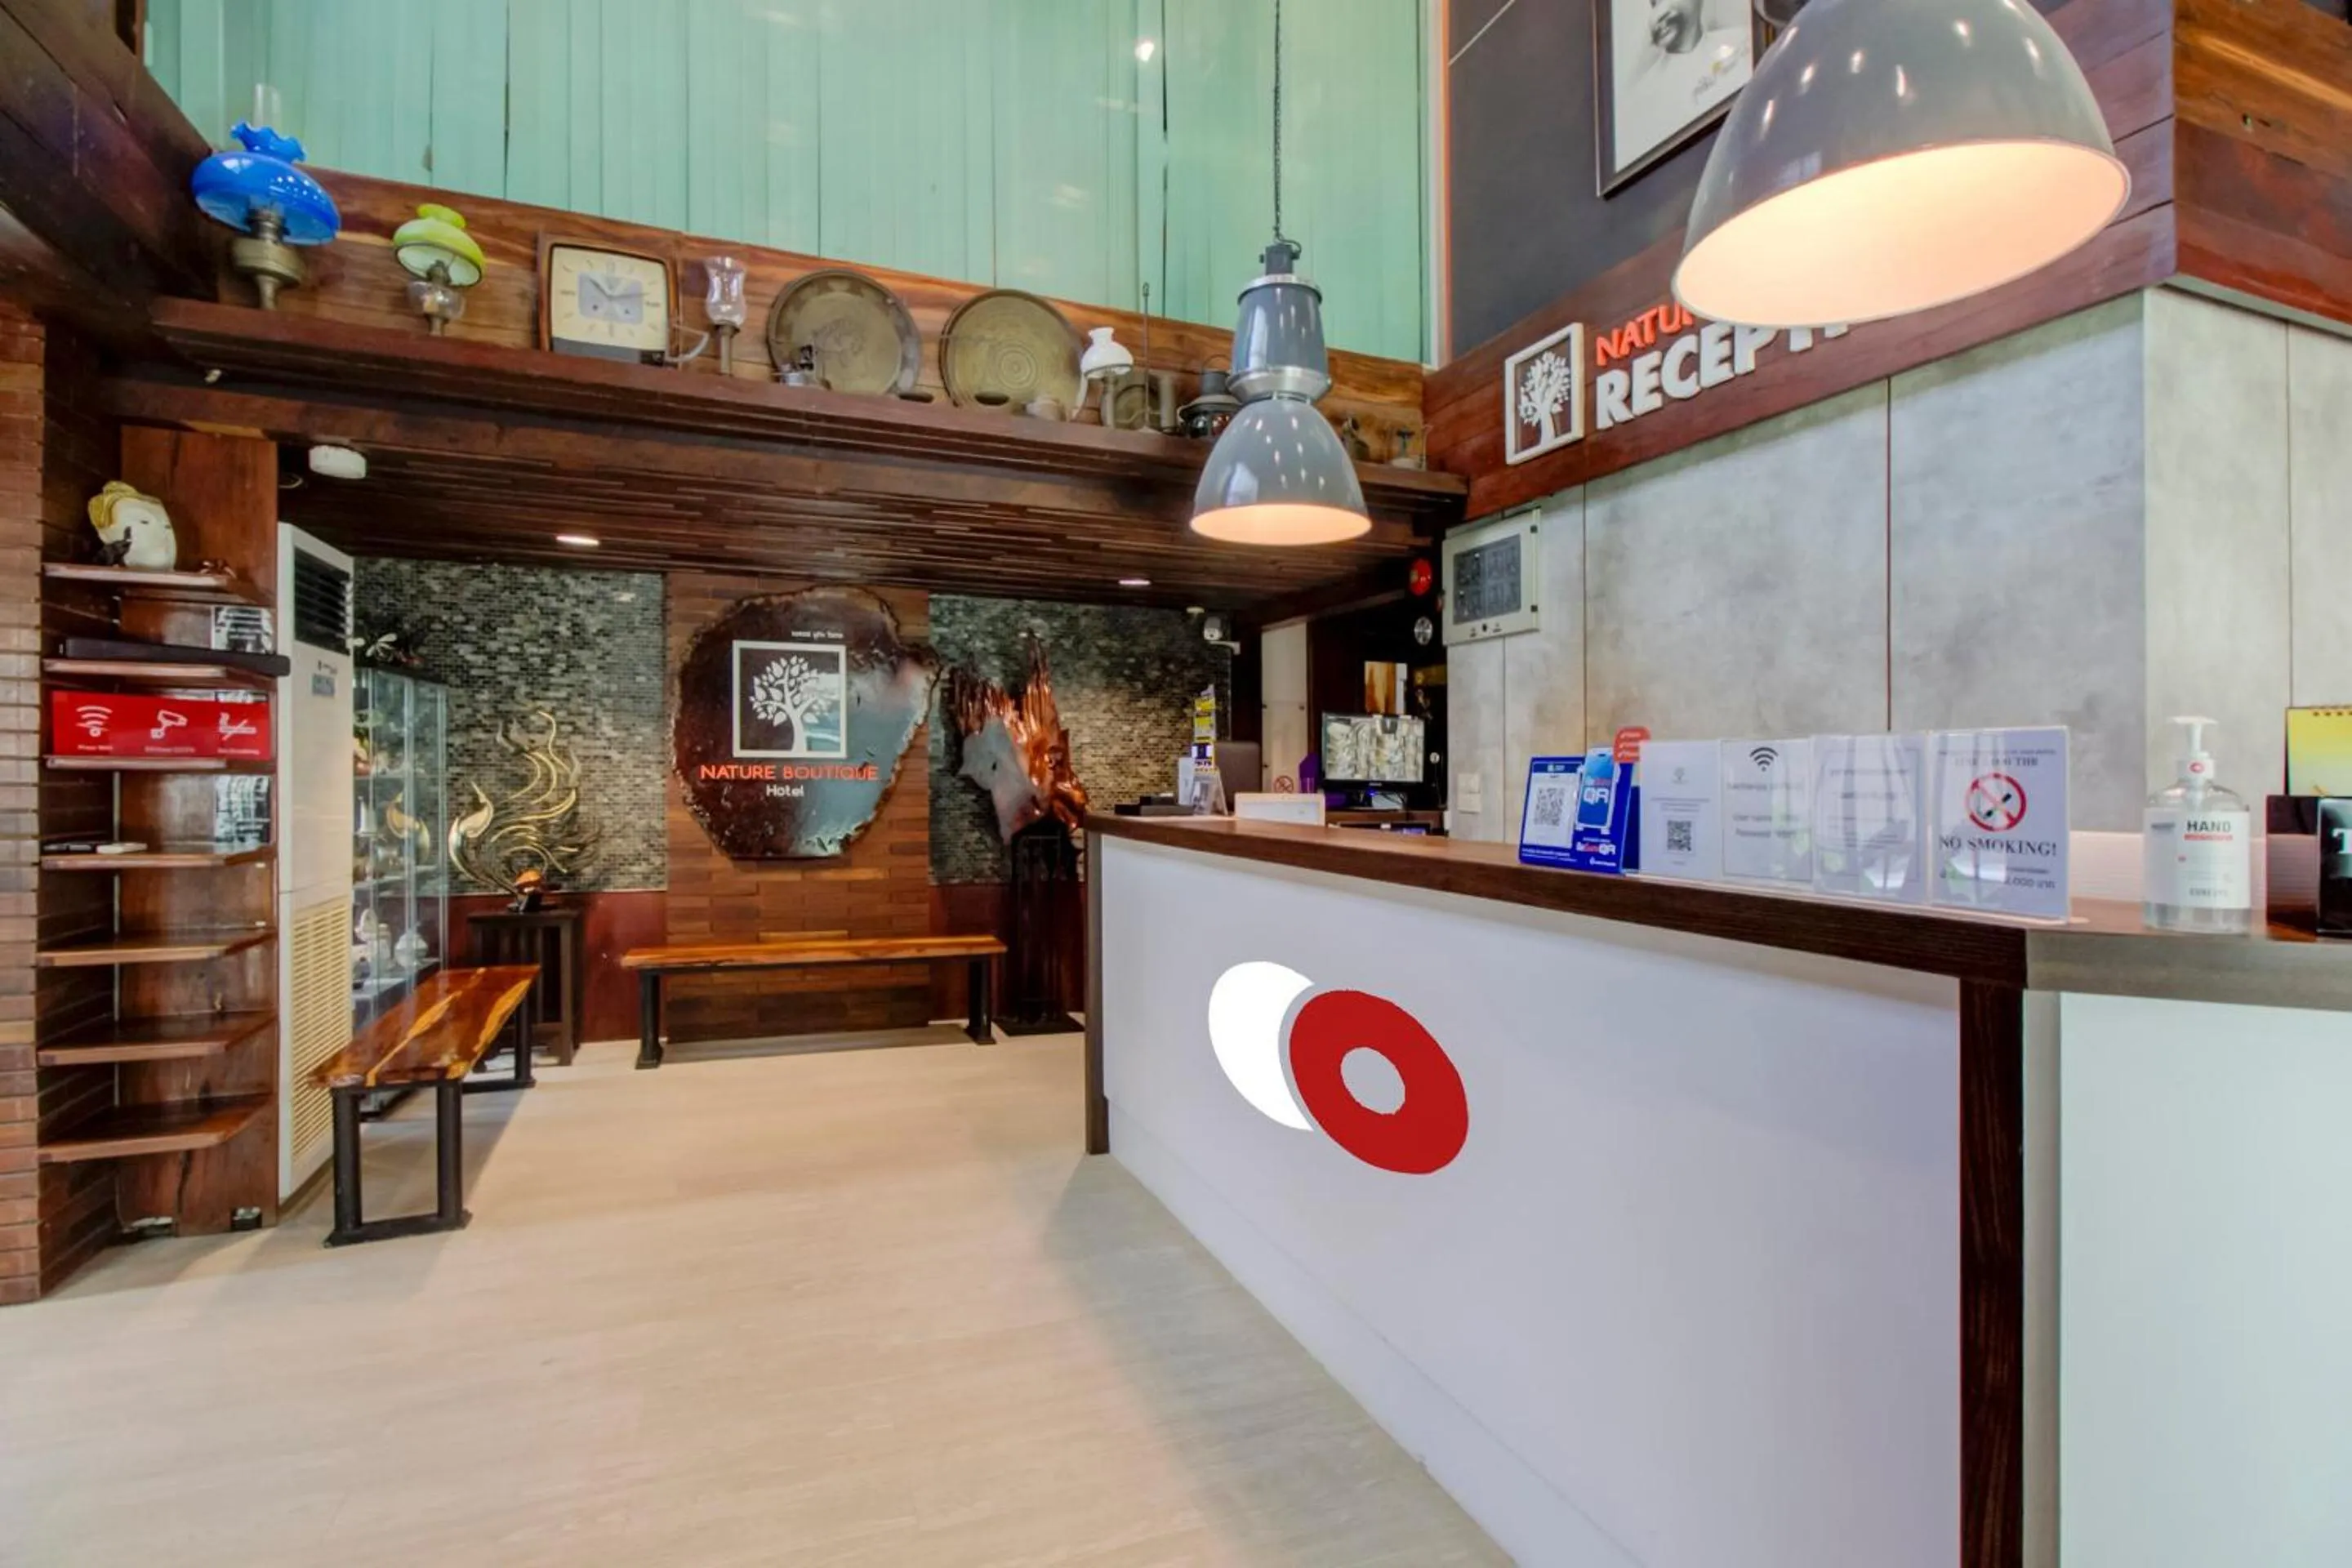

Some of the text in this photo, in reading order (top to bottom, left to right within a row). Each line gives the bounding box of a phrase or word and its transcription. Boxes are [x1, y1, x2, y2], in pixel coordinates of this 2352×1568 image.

[1596, 323, 1847, 430] RECEP
[699, 764, 879, 781] NATURE BOUTIQUE
[766, 784, 804, 797] Hotel
[2186, 821, 2232, 833] HAND
[1939, 834, 2057, 857] NO SMOKING!
